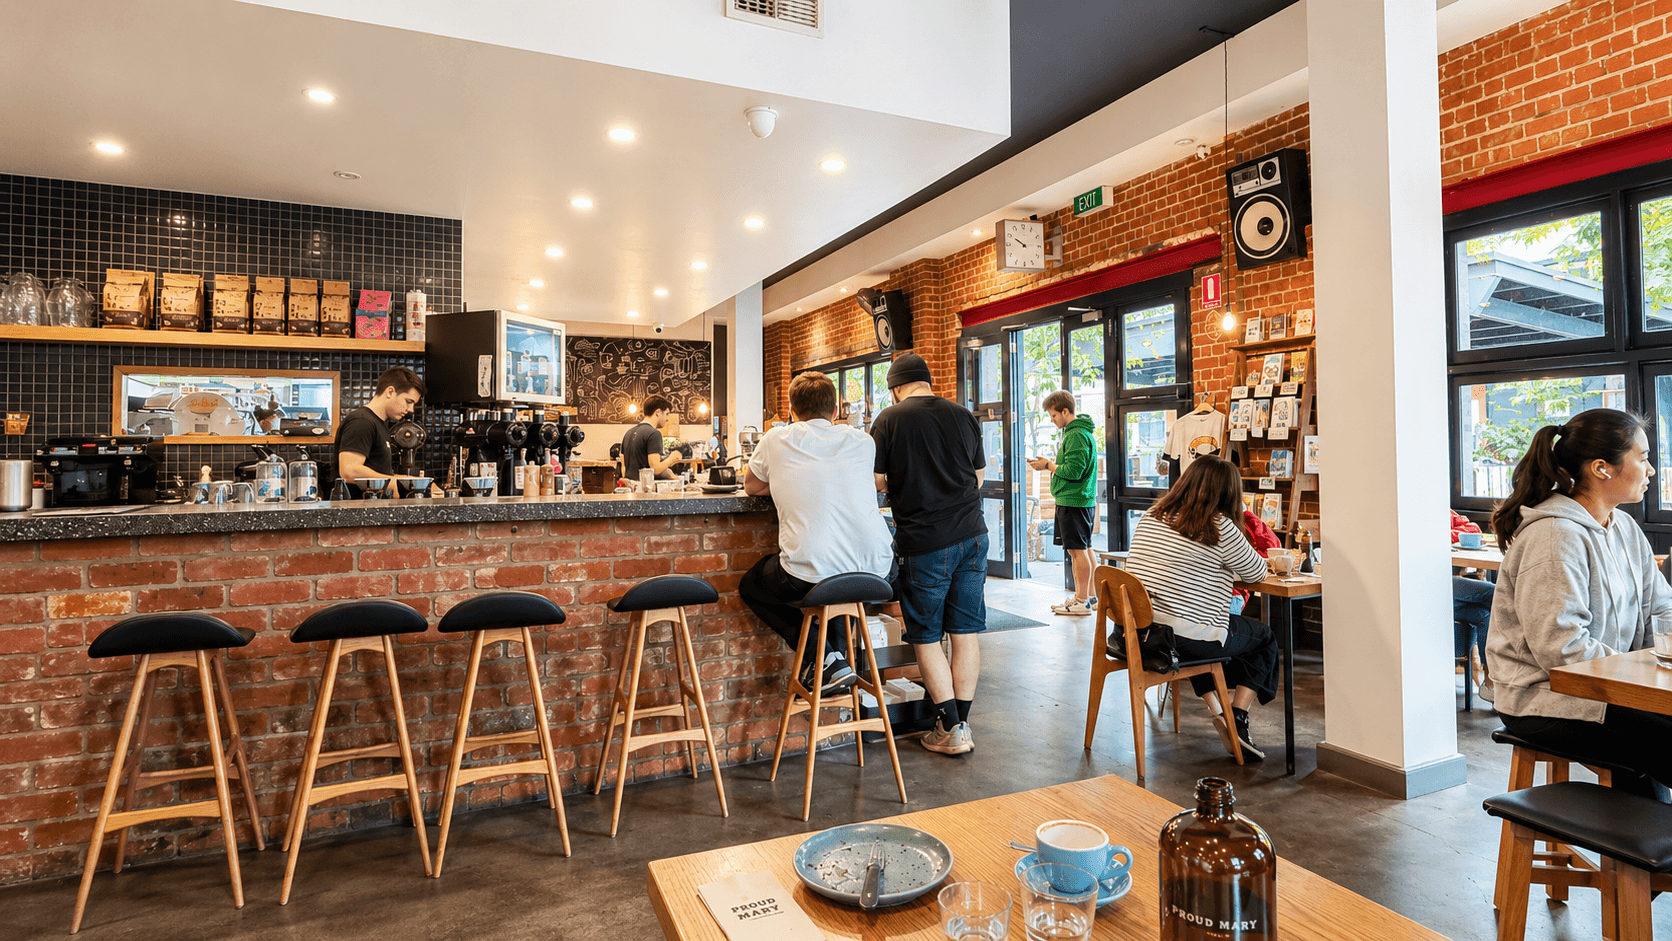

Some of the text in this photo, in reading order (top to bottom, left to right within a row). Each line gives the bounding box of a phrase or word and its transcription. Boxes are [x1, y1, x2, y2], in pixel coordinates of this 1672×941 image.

[1079, 191, 1096, 211] EXIT
[731, 898, 776, 913] PROUD
[737, 904, 779, 920] MARY
[1172, 904, 1214, 927] PROUD
[1219, 919, 1257, 931] MARY
